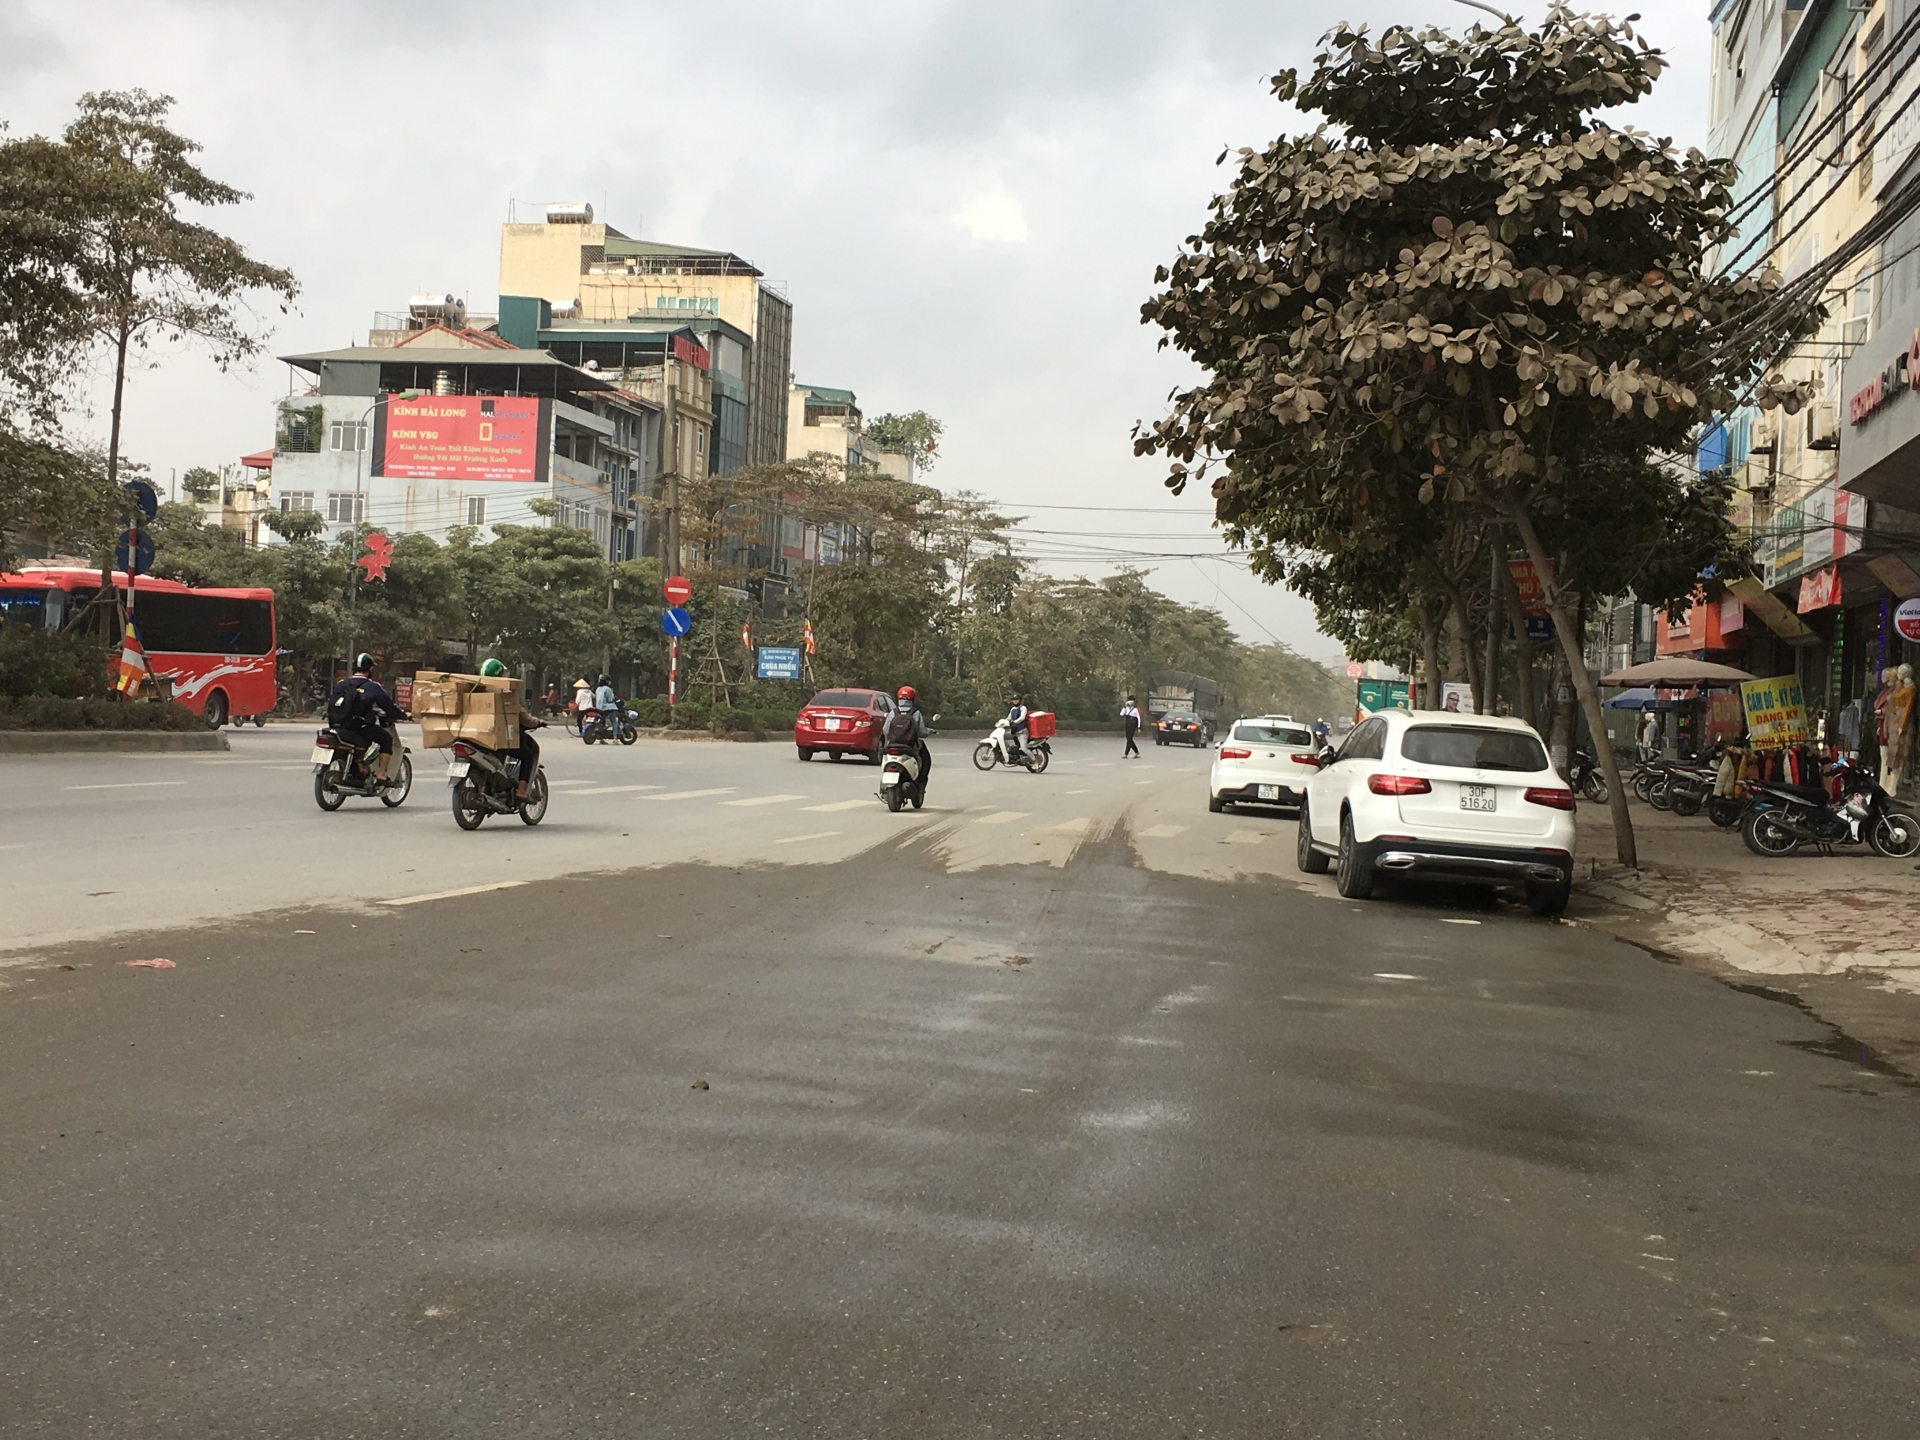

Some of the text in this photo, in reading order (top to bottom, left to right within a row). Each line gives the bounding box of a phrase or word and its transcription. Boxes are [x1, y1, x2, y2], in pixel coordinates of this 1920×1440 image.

[393, 405, 467, 417] KÍNH HẢI LONG
[392, 428, 439, 439] KÍNH VSG
[761, 661, 778, 670] CHÙA
[1785, 708, 1798, 720] KÝ
[1468, 786, 1487, 798] 30F
